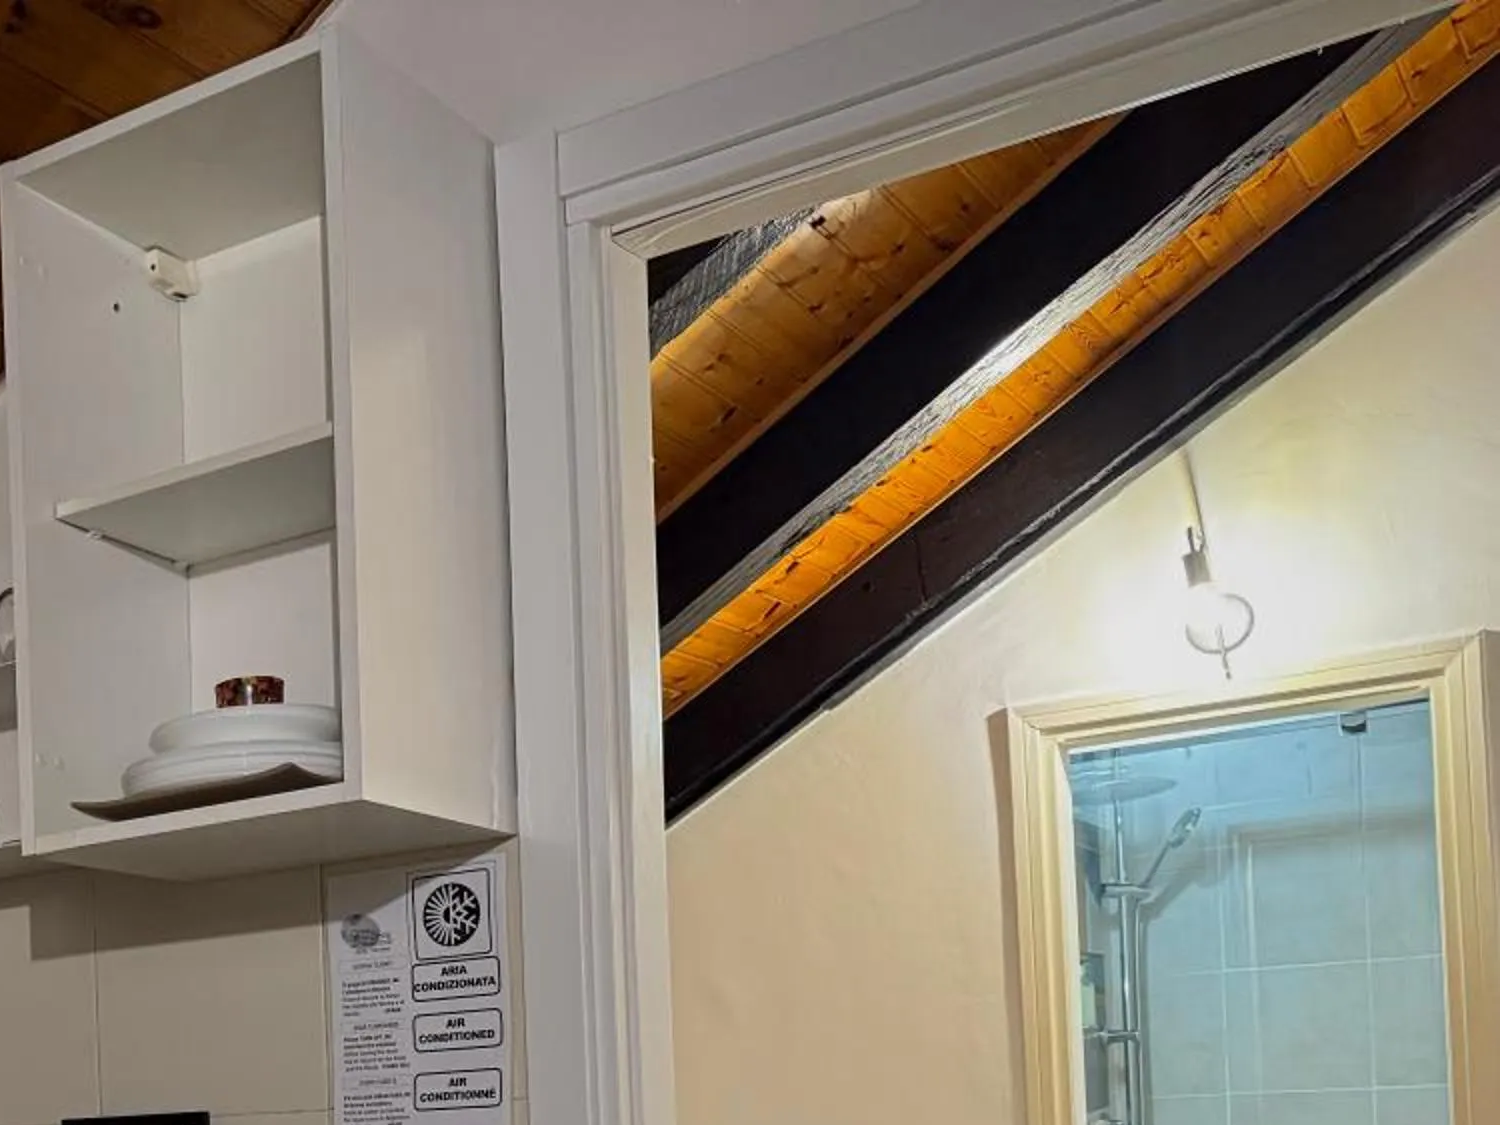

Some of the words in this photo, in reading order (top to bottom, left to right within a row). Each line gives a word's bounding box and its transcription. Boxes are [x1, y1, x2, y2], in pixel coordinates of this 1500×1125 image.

[440, 965, 467, 976] ARIA
[413, 976, 496, 993] CONDIZIONATA
[445, 1017, 466, 1028] AIR
[419, 1029, 495, 1044] CONDITIONED
[448, 1077, 467, 1087] AIR
